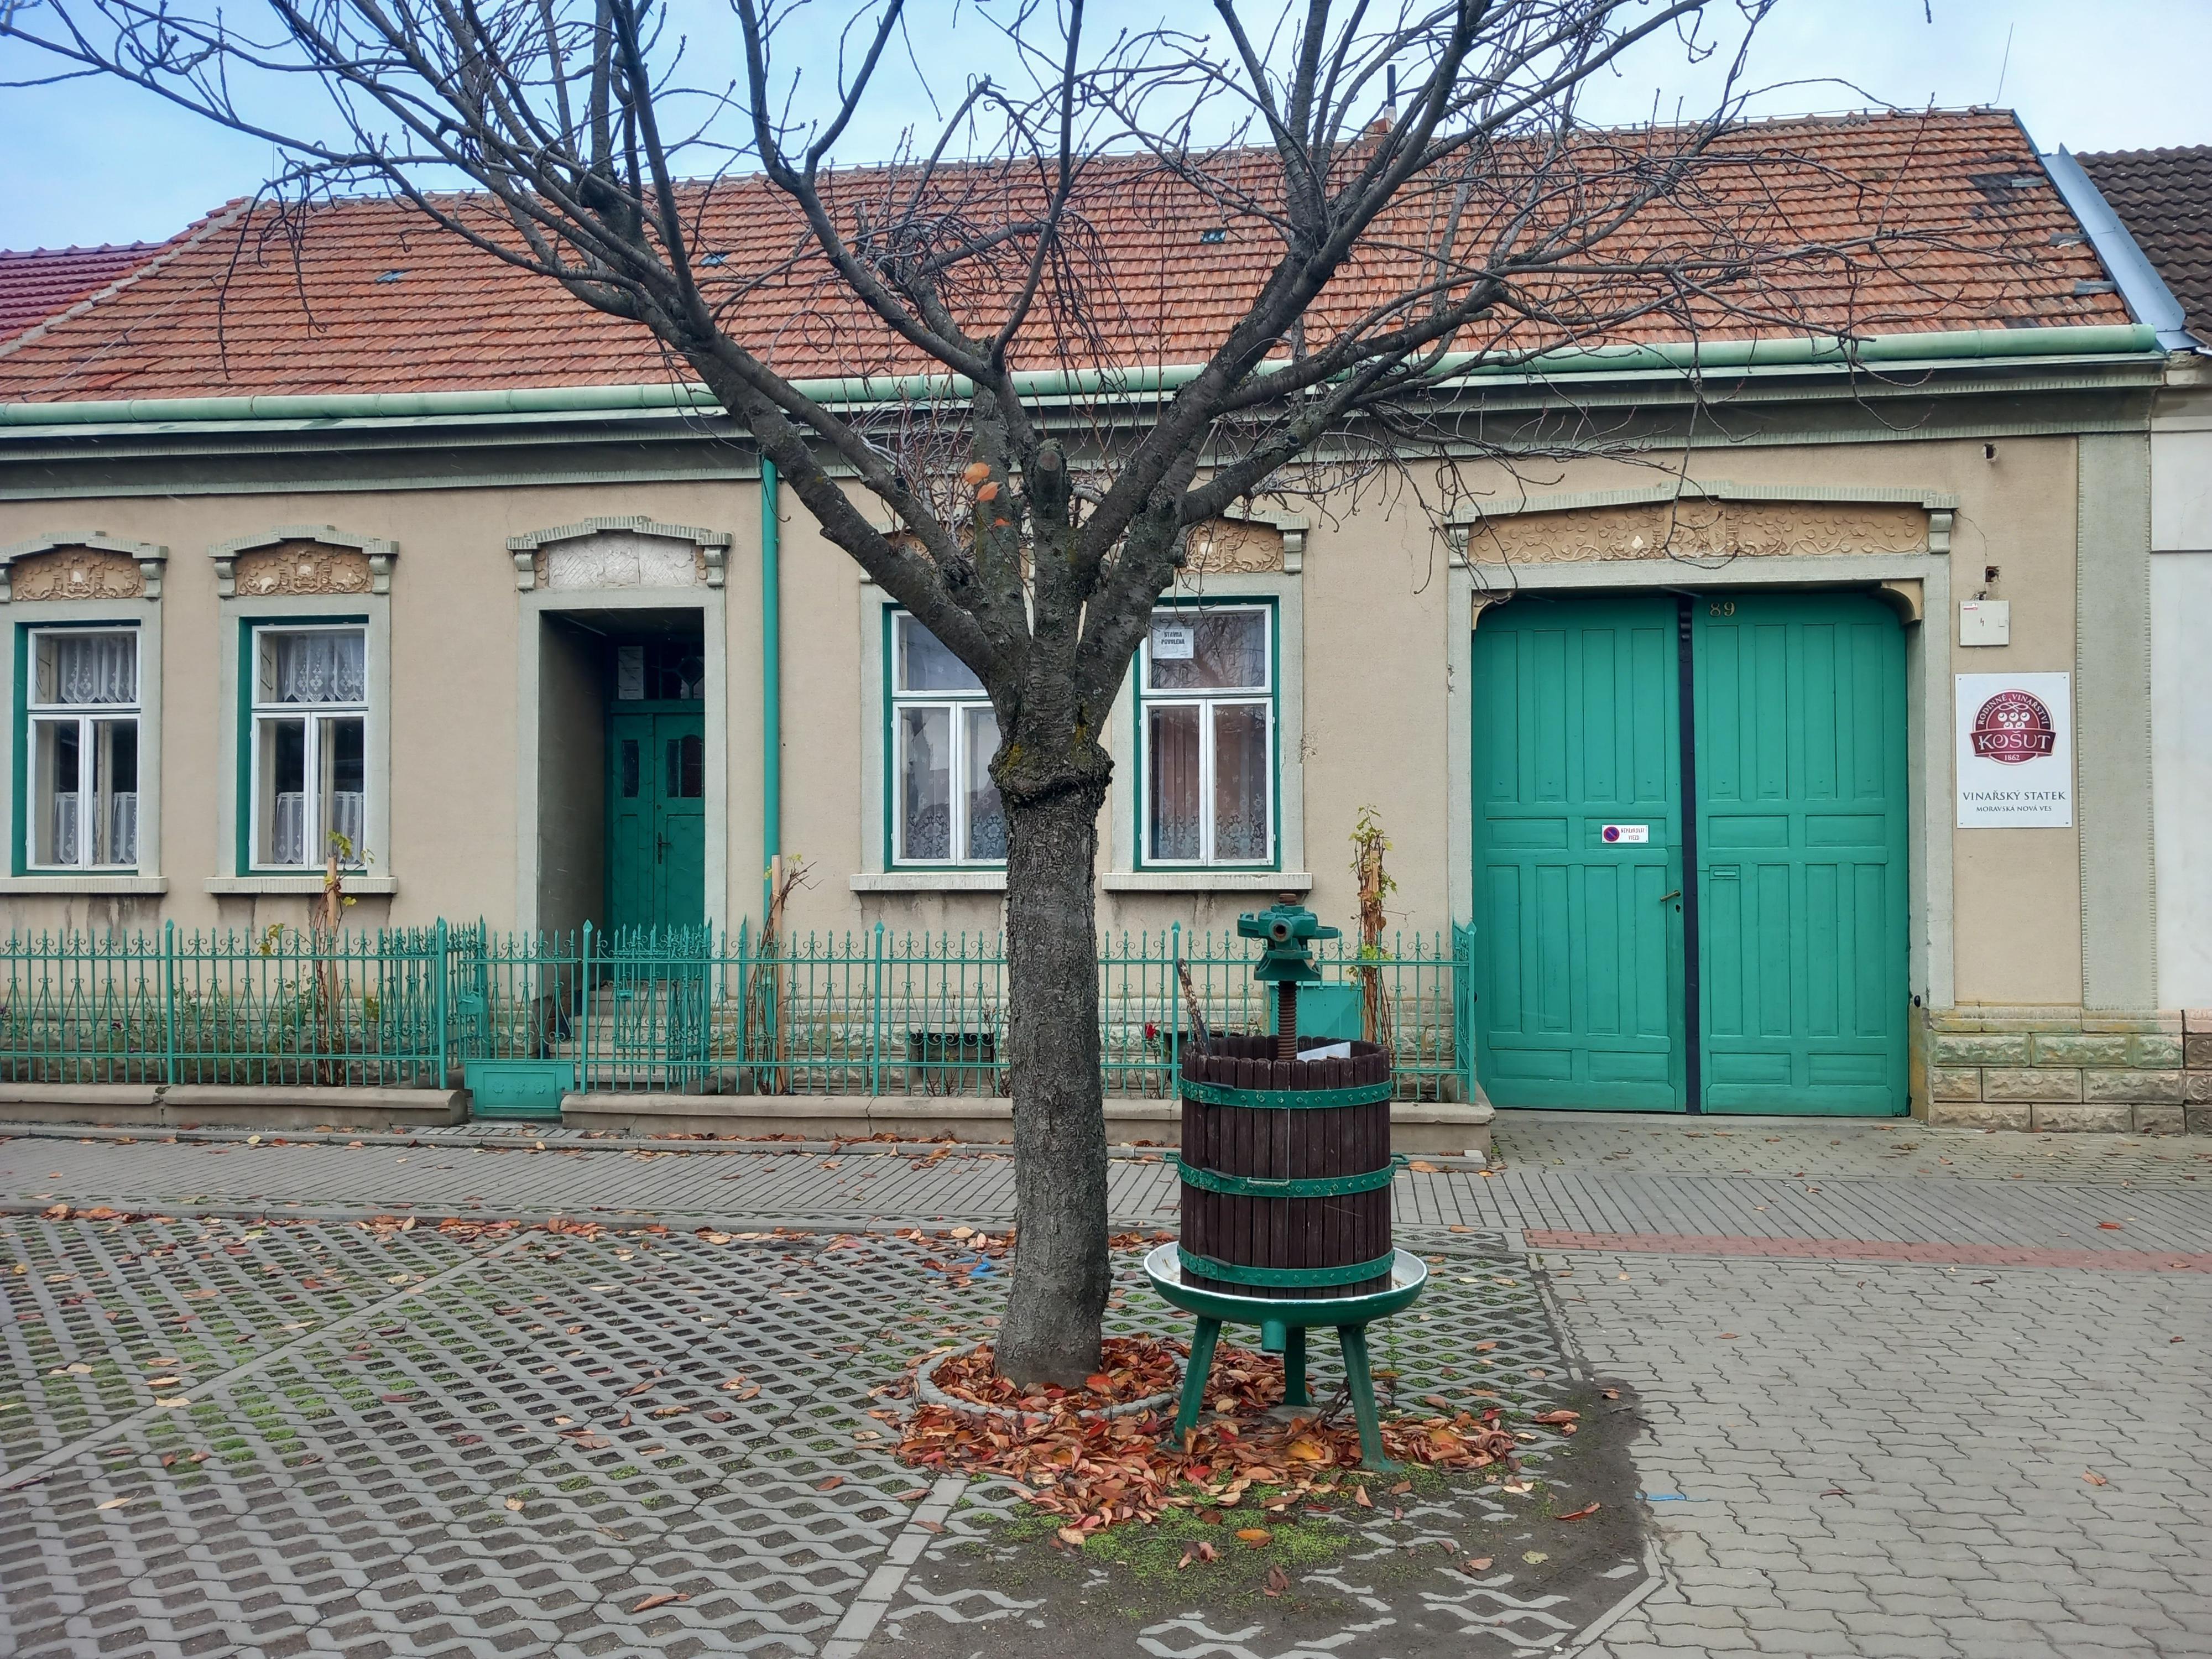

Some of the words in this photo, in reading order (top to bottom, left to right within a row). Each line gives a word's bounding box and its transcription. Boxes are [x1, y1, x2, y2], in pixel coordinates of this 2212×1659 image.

[1710, 602, 1735, 616] 89
[1978, 694, 2007, 725] RODINNÉ
[1979, 731, 2051, 750] KOŠUT
[1963, 790, 2021, 800] VINAŘSKÝ
[2024, 791, 2066, 800] STATEK
